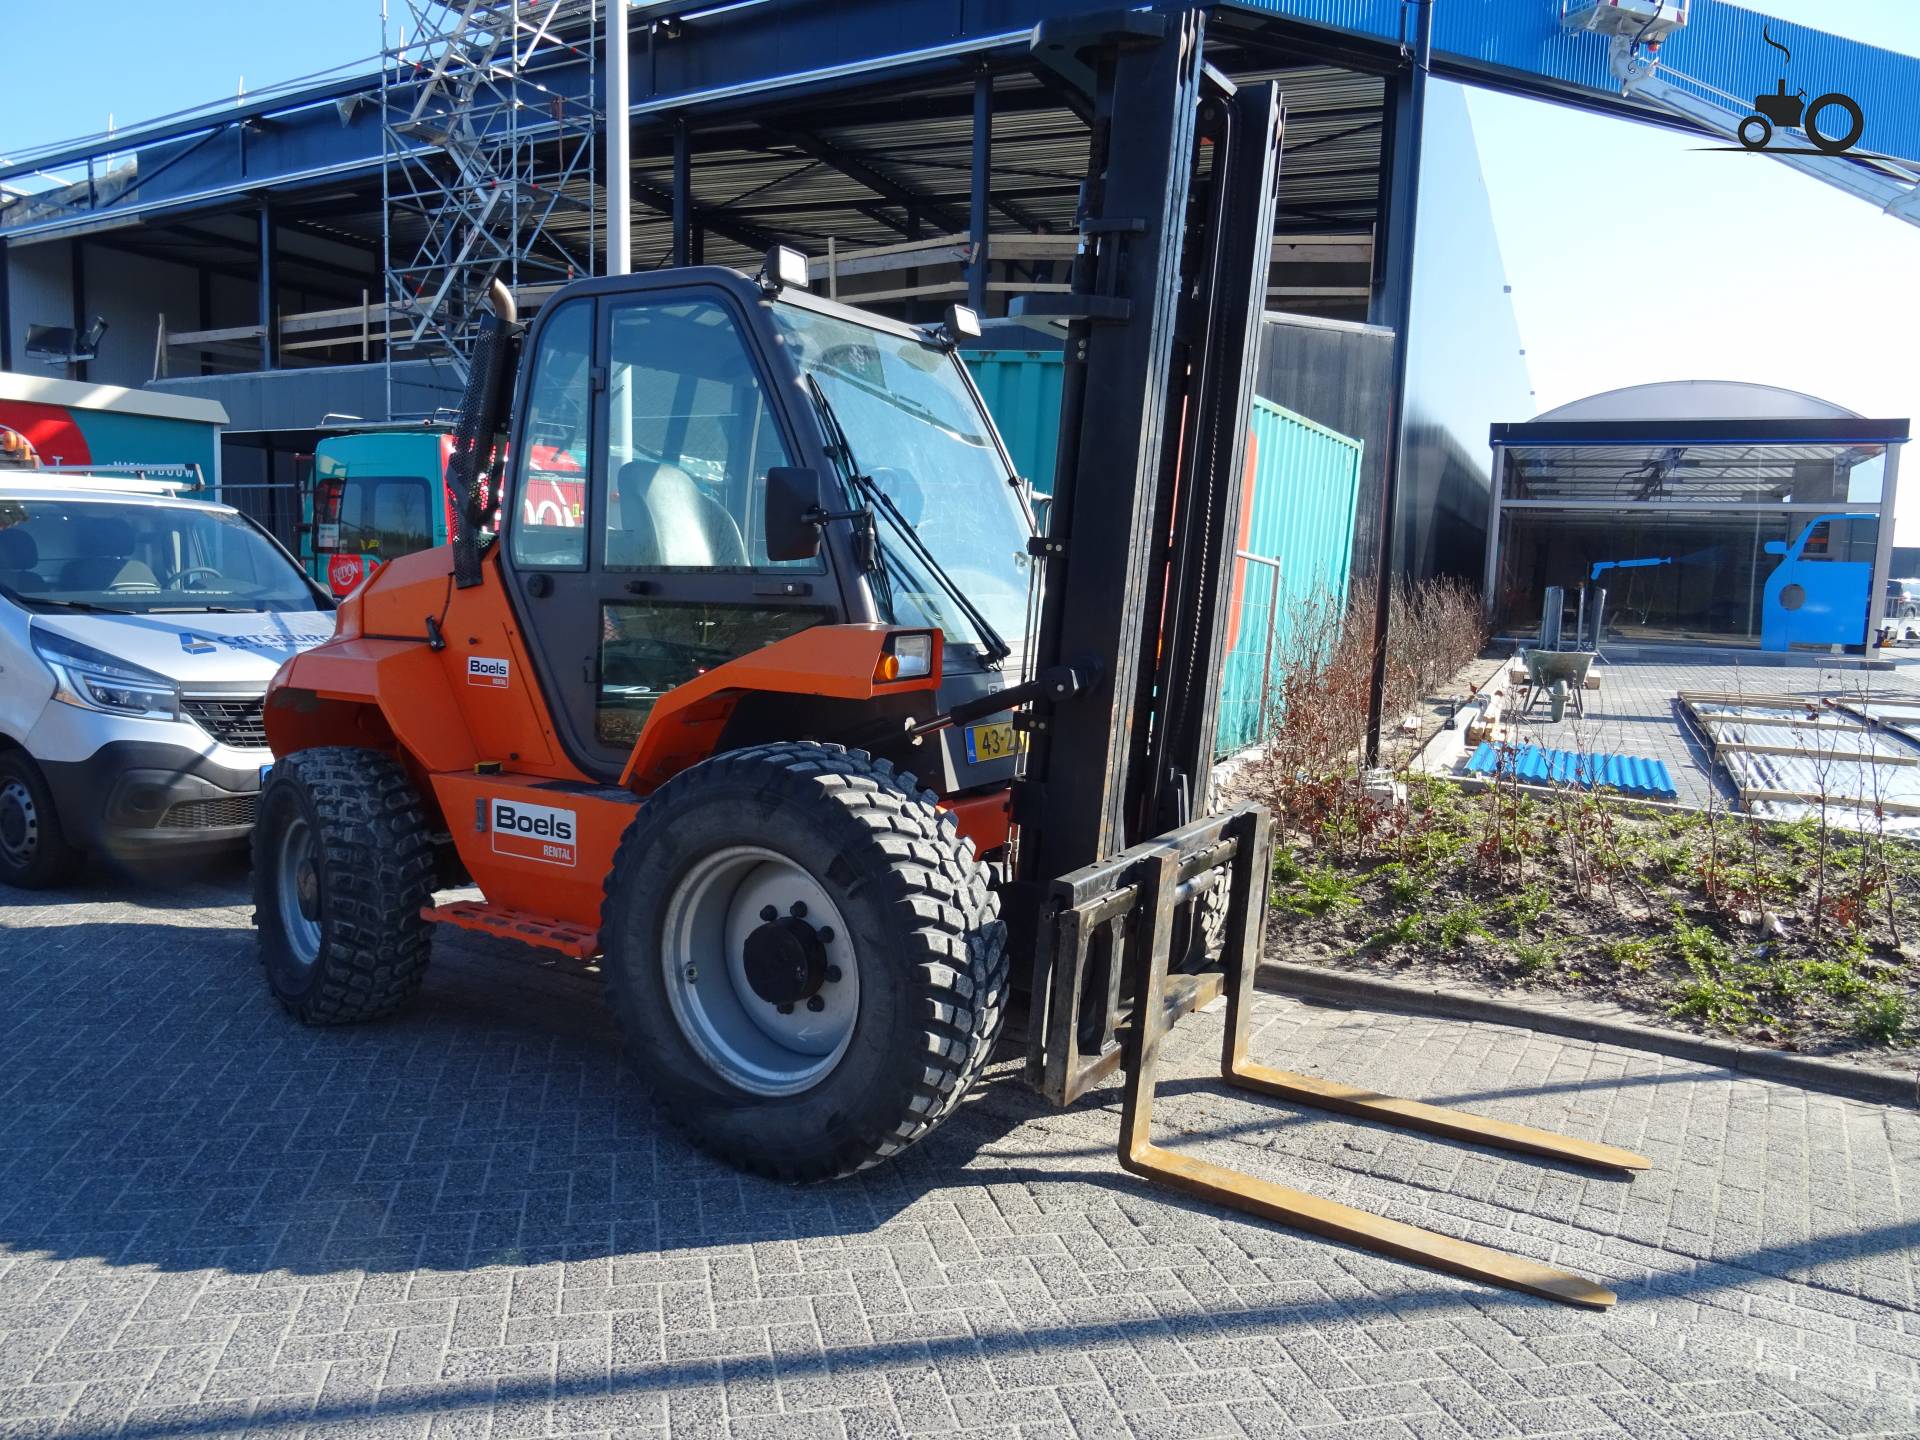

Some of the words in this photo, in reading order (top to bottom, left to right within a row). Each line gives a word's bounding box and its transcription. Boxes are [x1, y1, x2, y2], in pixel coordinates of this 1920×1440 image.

[470, 660, 507, 675] Boels
[496, 805, 572, 840] Boels
[543, 844, 572, 860] RENTAL
